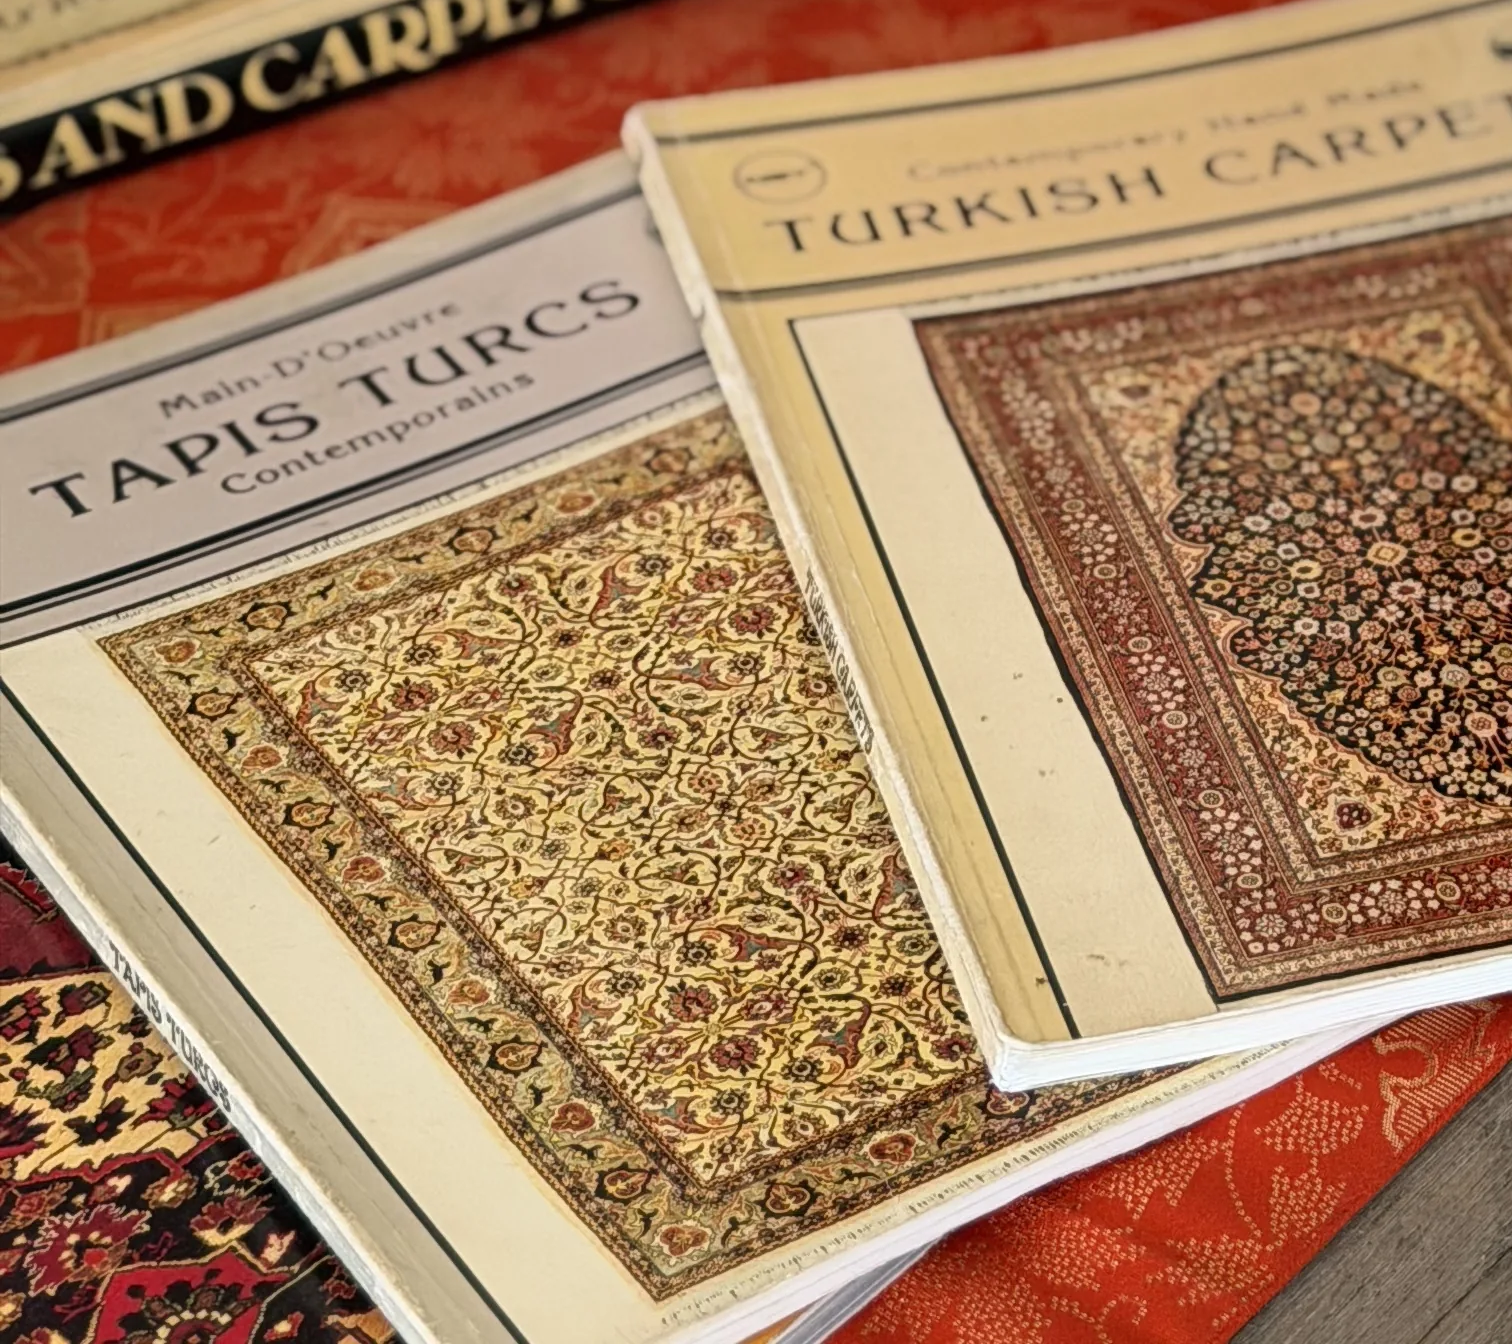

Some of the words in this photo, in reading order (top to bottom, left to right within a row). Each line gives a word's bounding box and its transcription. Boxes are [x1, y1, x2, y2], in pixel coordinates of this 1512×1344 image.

[28, 70, 236, 191] AND
[763, 165, 1168, 256] TURKISH
[27, 399, 321, 520] TAPIS
[336, 276, 643, 409] TURCS
[219, 368, 537, 497] Contemporains
[107, 939, 163, 1025] TAPIS
[166, 1011, 232, 1113] TURCS
